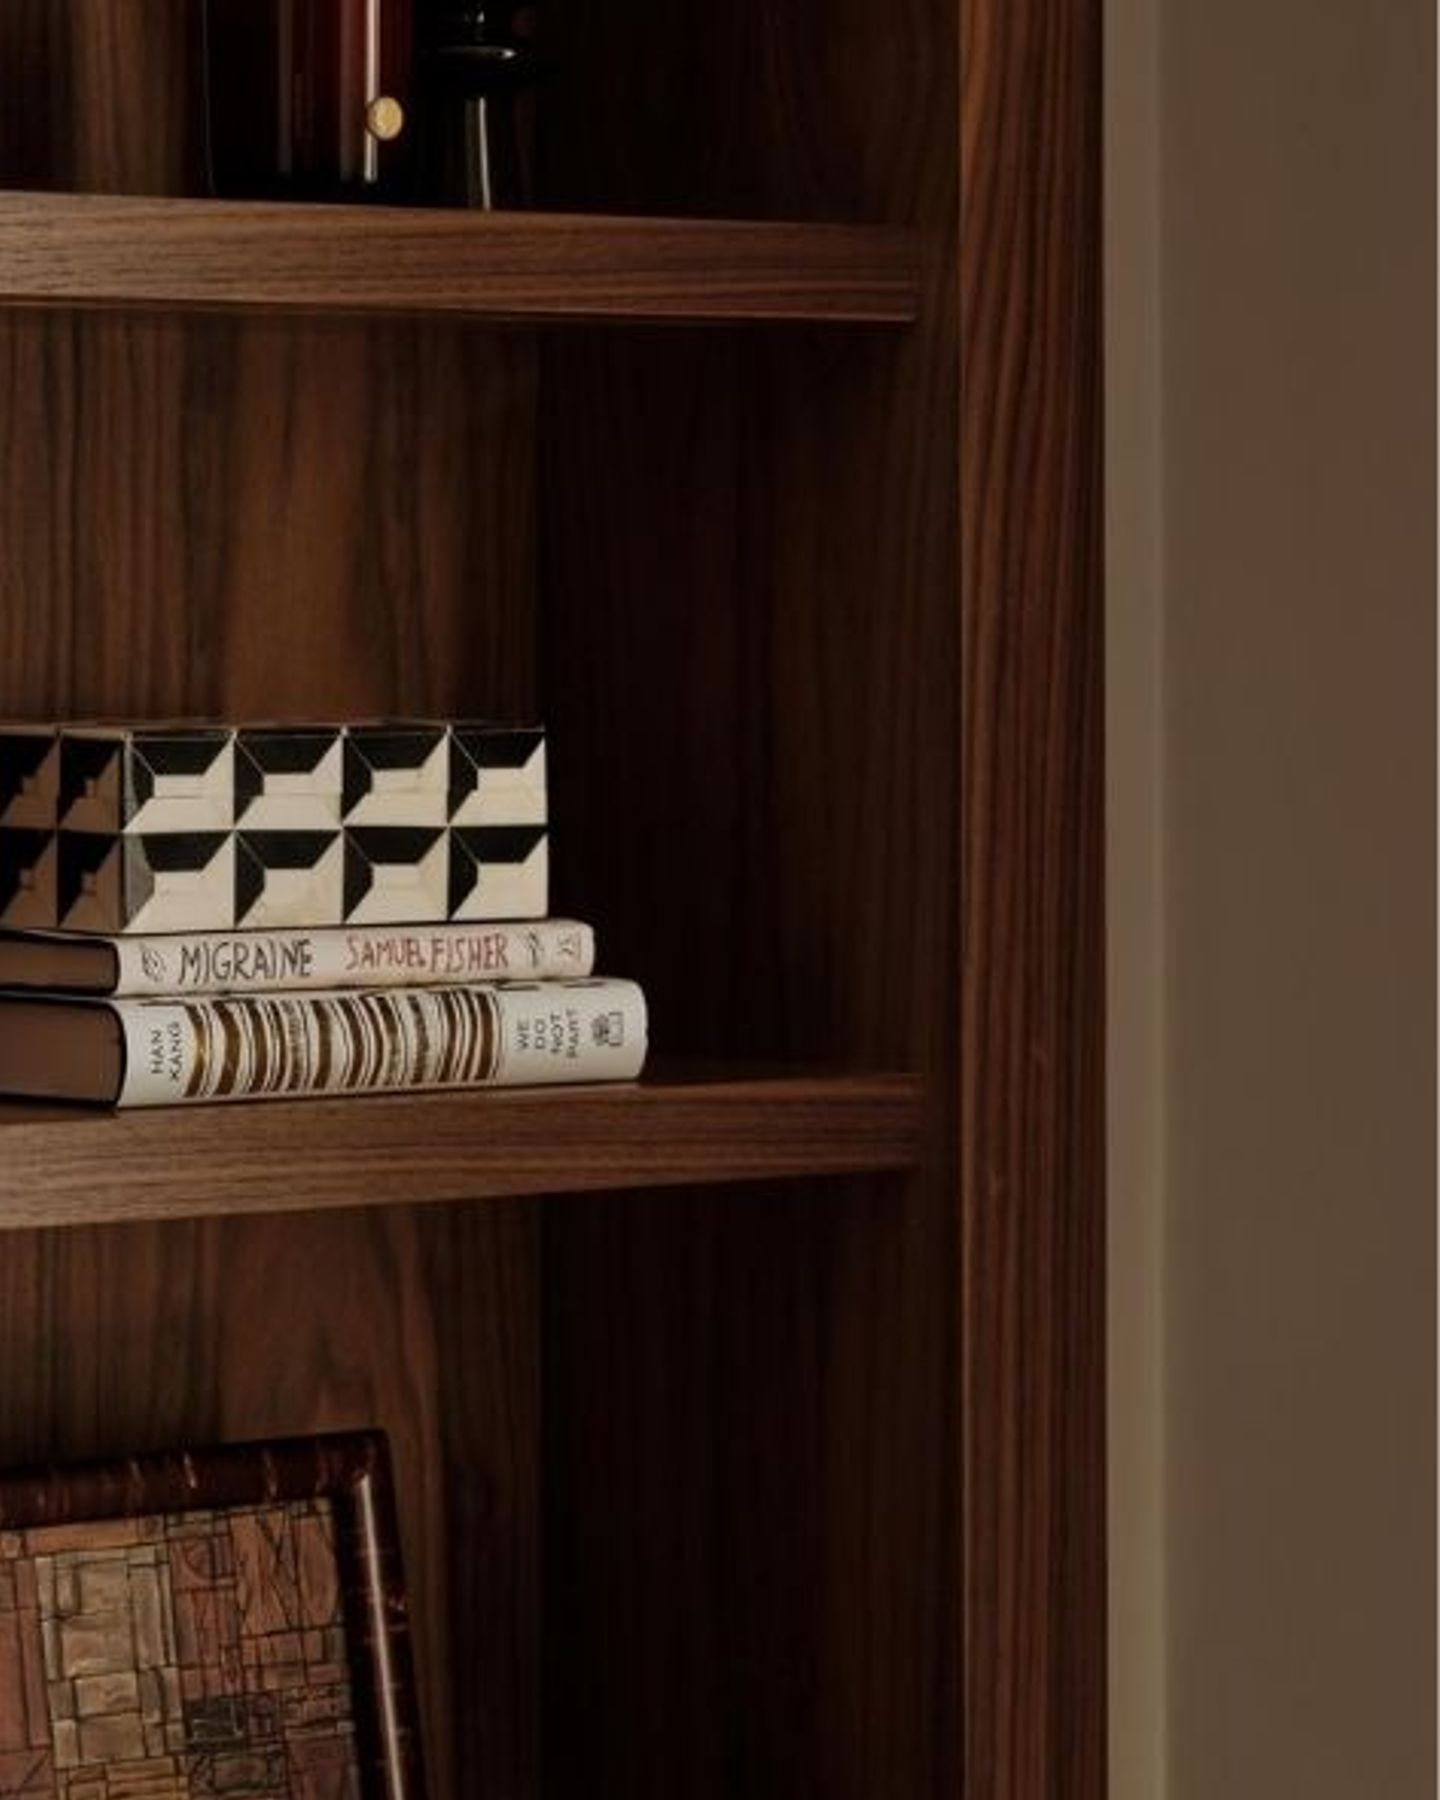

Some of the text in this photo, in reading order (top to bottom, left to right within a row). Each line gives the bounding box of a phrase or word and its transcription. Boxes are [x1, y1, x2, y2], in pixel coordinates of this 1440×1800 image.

[179, 939, 311, 985] MIGRAINE
[346, 931, 510, 974] SAMUEL FISHER
[151, 1029, 164, 1074] HAN
[168, 1021, 182, 1082] KANG
[516, 1019, 529, 1052] WE
[535, 1017, 545, 1050] DO
[550, 1012, 563, 1055] NOT
